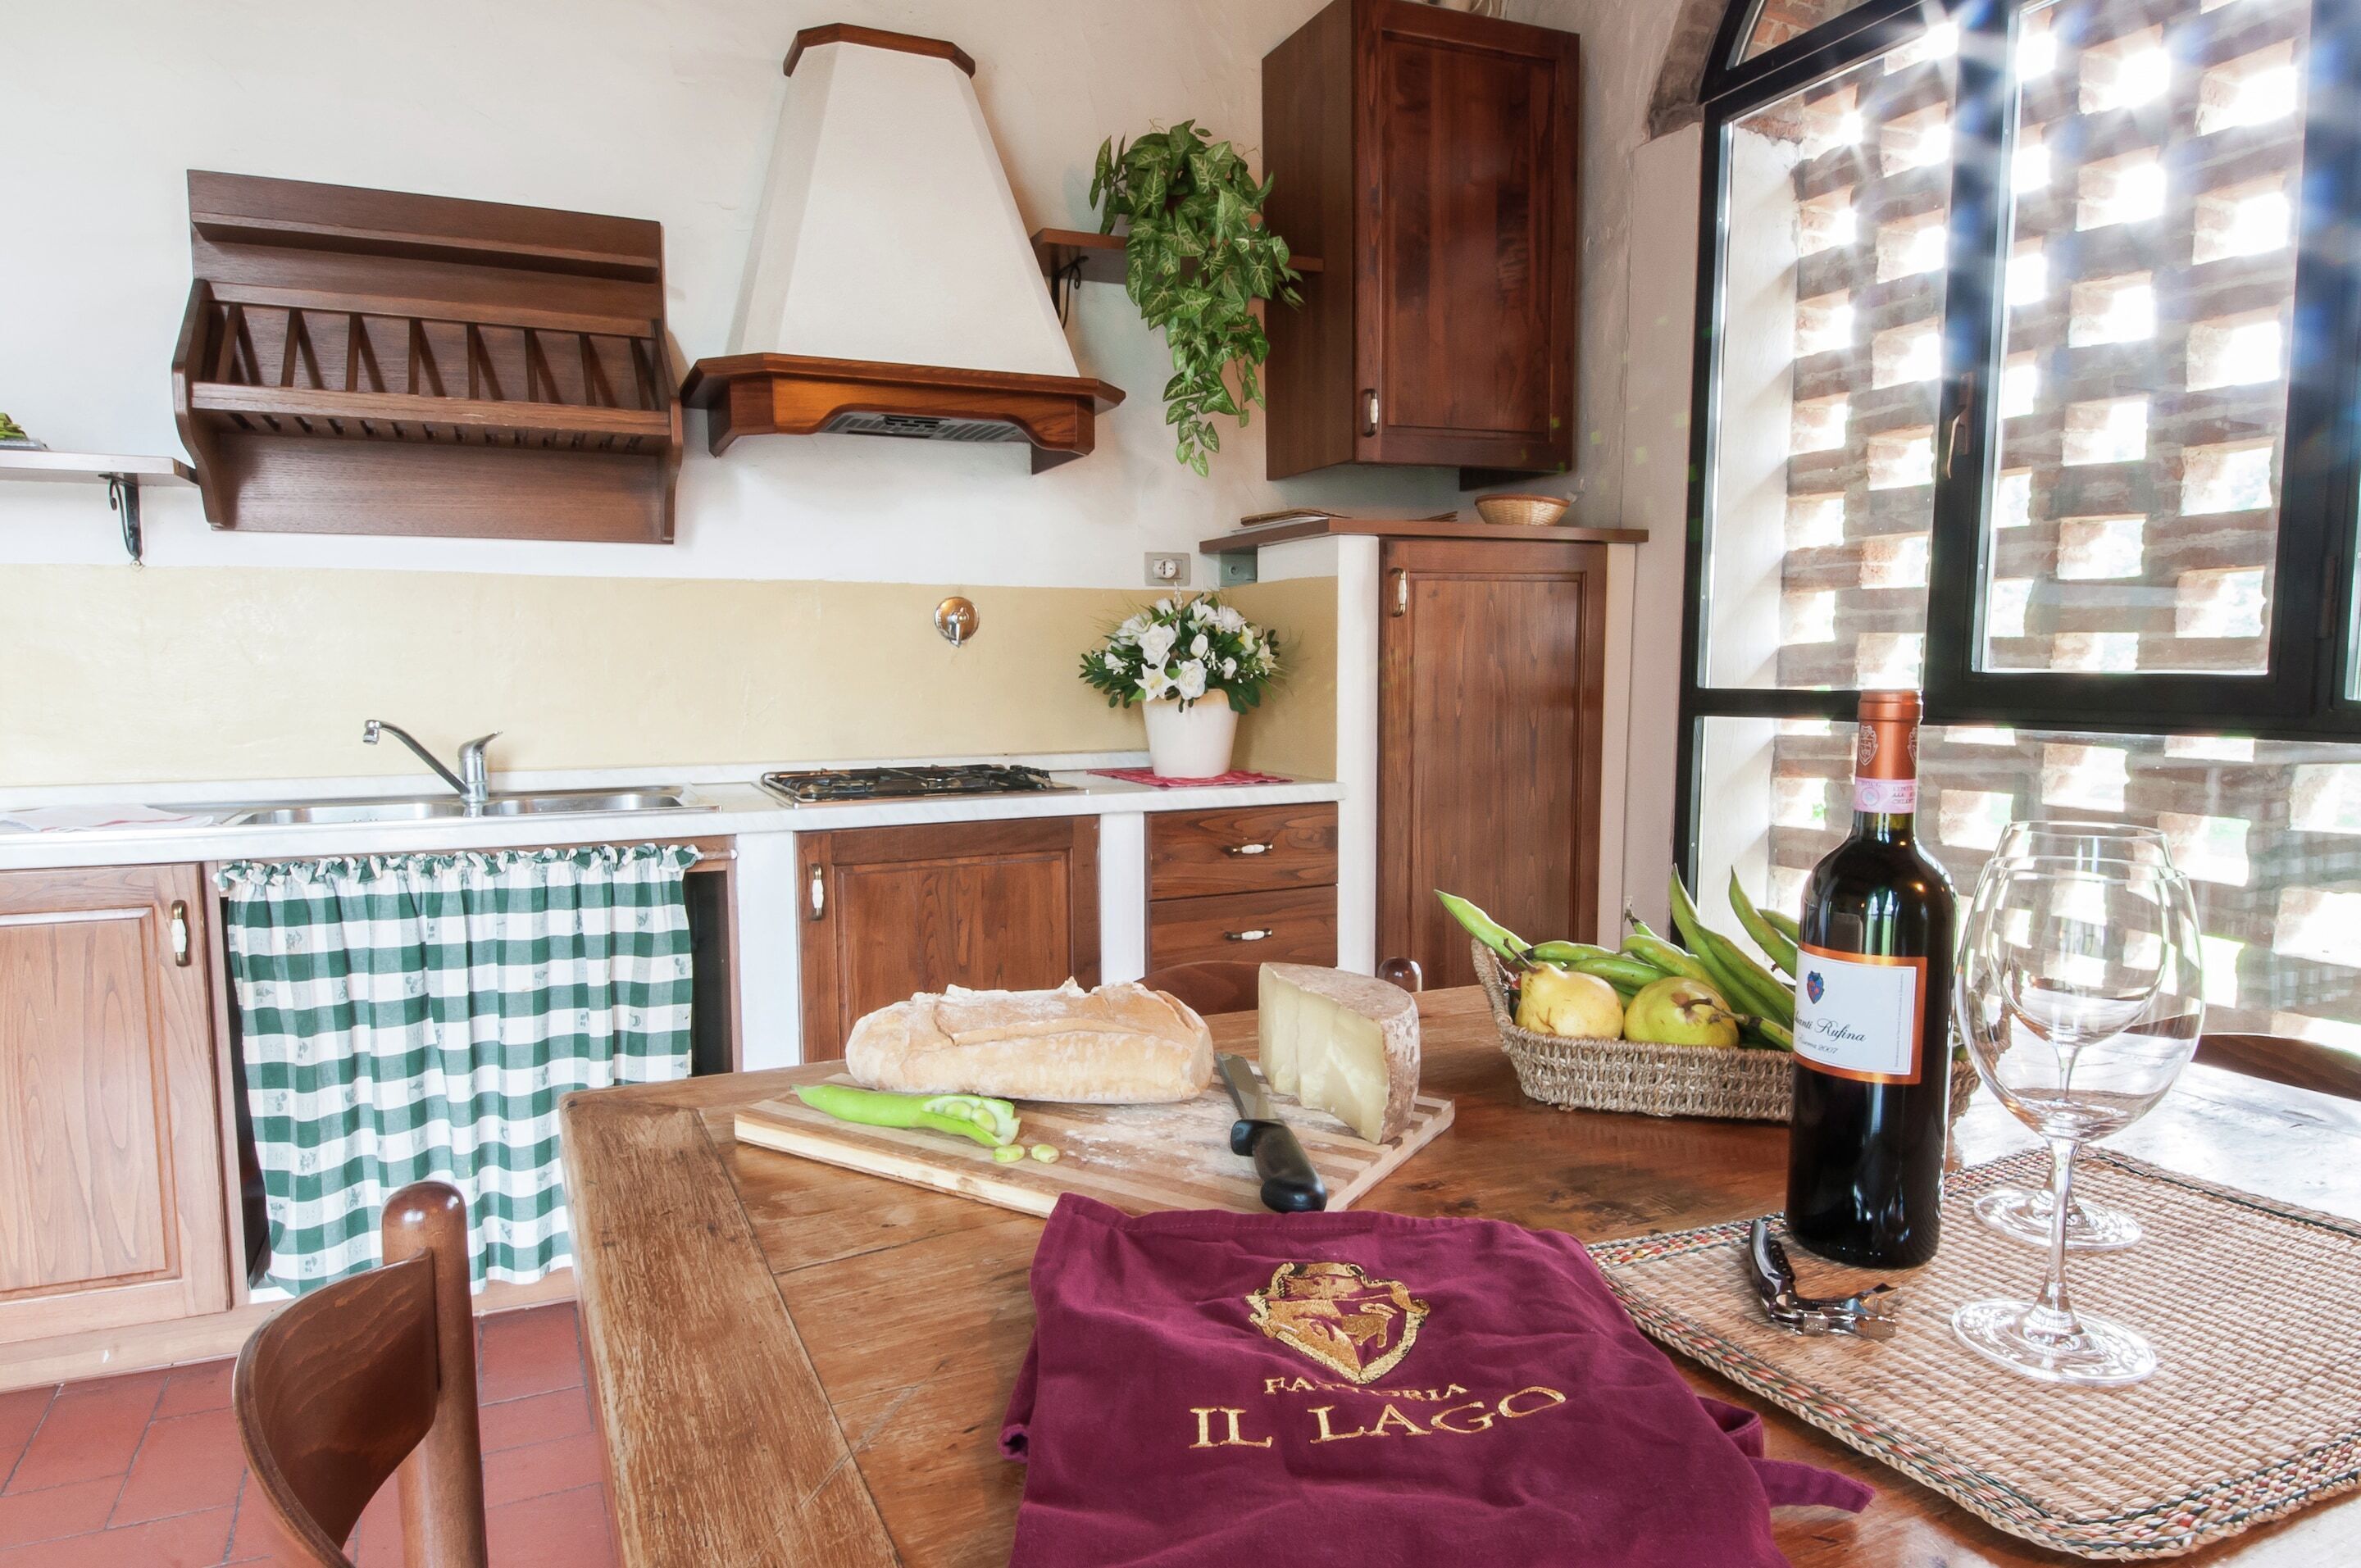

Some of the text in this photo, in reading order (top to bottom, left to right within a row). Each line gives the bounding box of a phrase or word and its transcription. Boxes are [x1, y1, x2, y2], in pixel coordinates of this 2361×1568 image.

[1814, 1017, 1866, 1042] Rufina
[1189, 1386, 1567, 1448] IL LAGO
